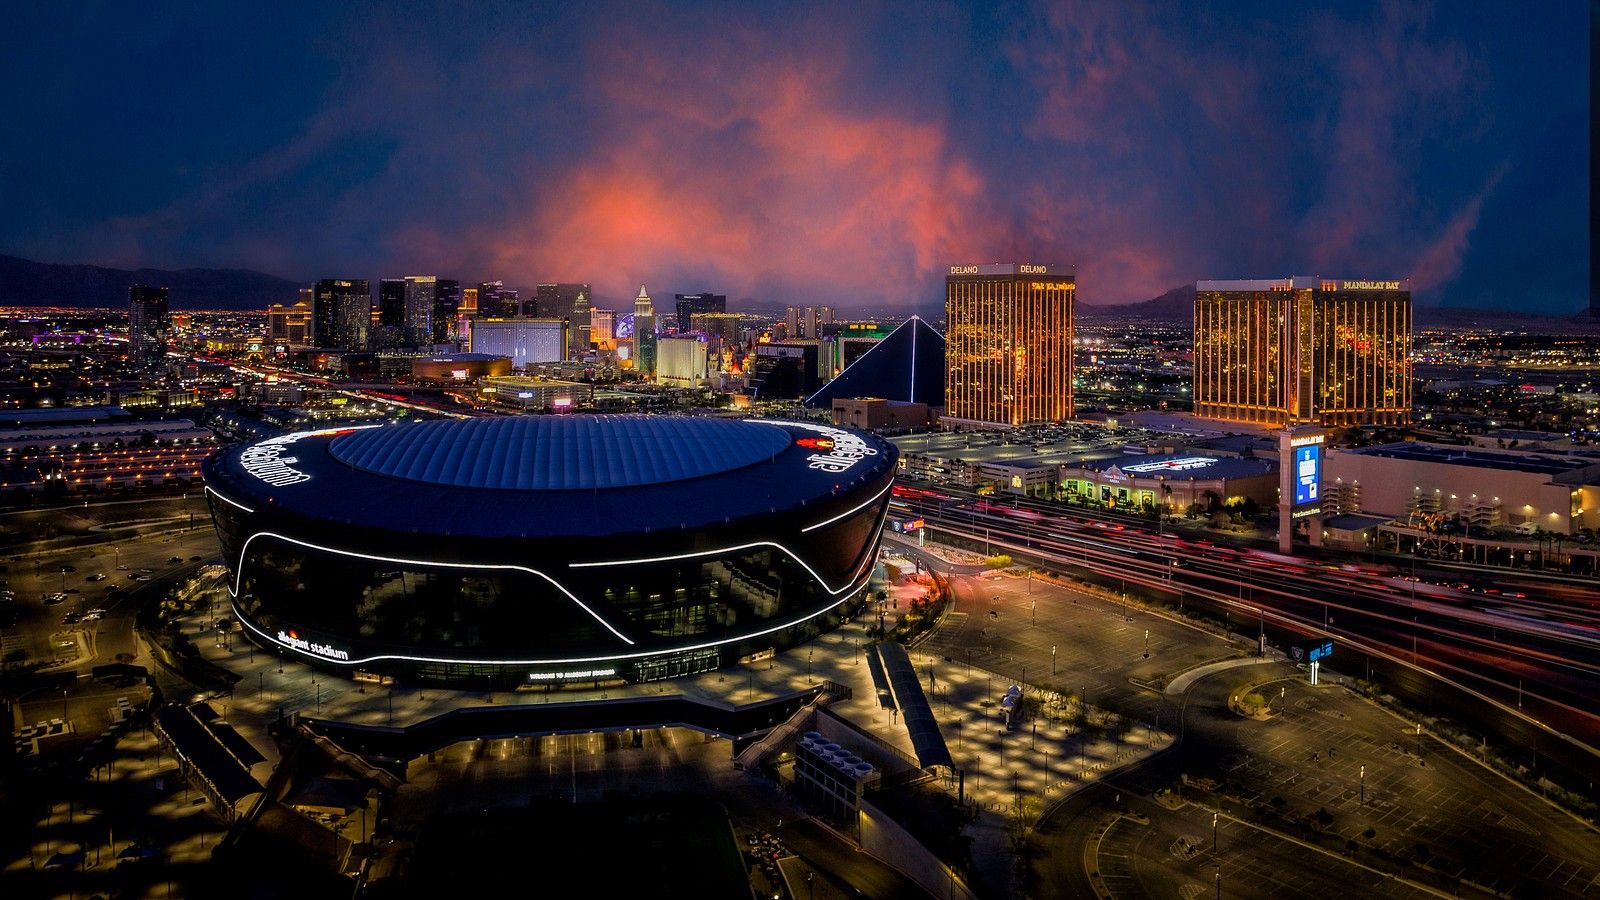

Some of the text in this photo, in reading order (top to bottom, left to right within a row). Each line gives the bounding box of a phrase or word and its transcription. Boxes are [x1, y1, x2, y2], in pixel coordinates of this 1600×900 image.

[951, 266, 978, 274] DELANO
[1020, 265, 1046, 274] DELANO
[1343, 280, 1400, 290] MANDALAY BAY
[310, 643, 348, 660] stadium
